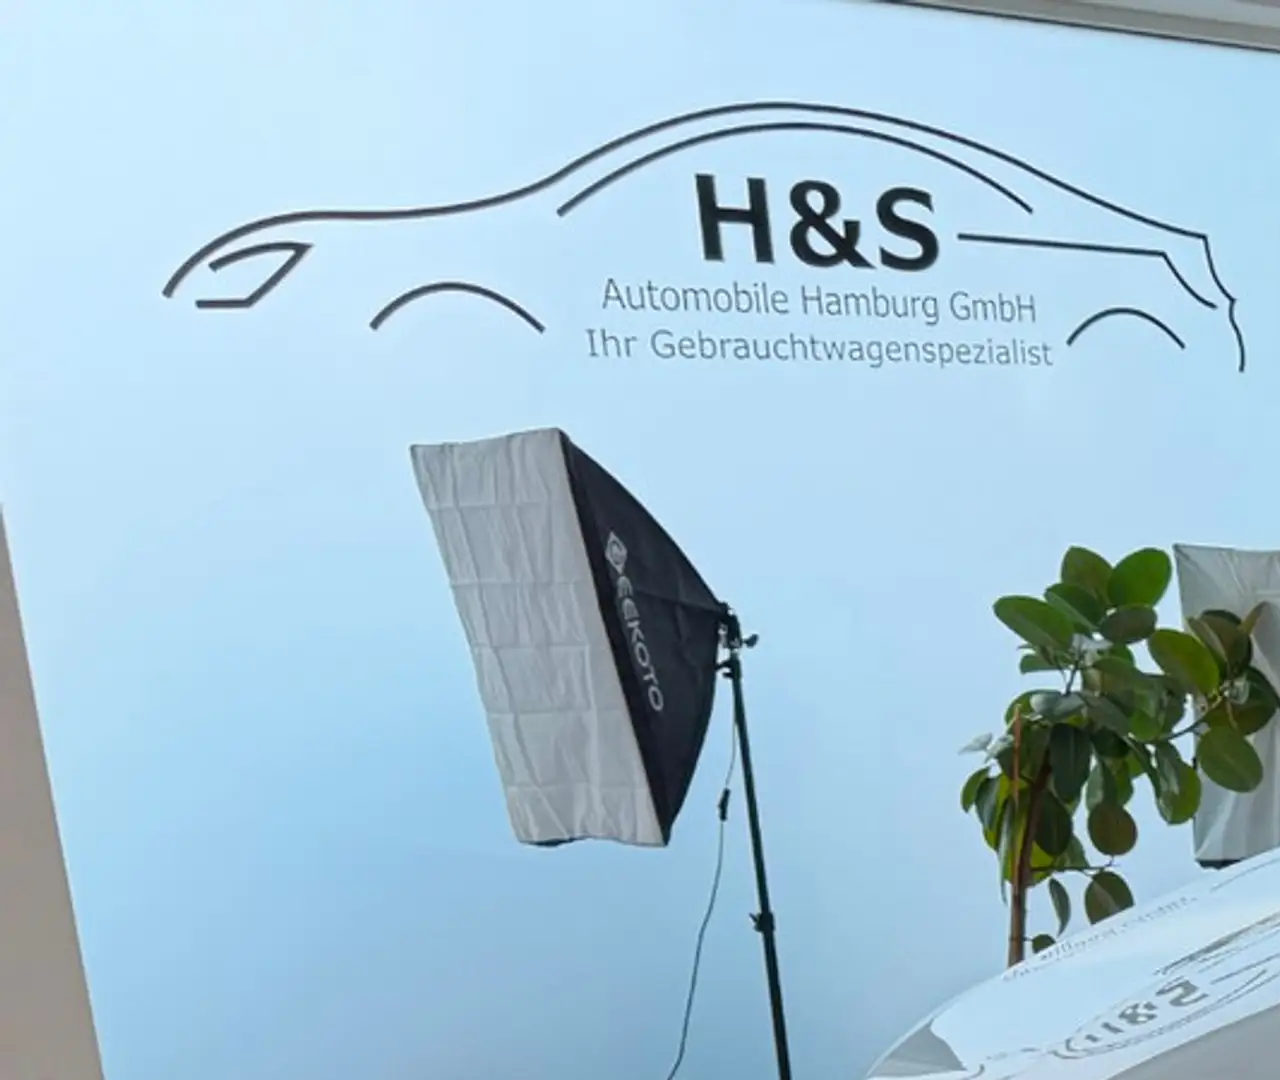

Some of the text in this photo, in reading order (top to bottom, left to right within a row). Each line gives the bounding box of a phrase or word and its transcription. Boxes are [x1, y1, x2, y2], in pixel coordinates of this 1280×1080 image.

[694, 173, 939, 272] H&S
[602, 277, 1037, 326] Automobile Hamburg GmbH
[585, 327, 1054, 369] Ihr Gebrauchtwagenspezialist
